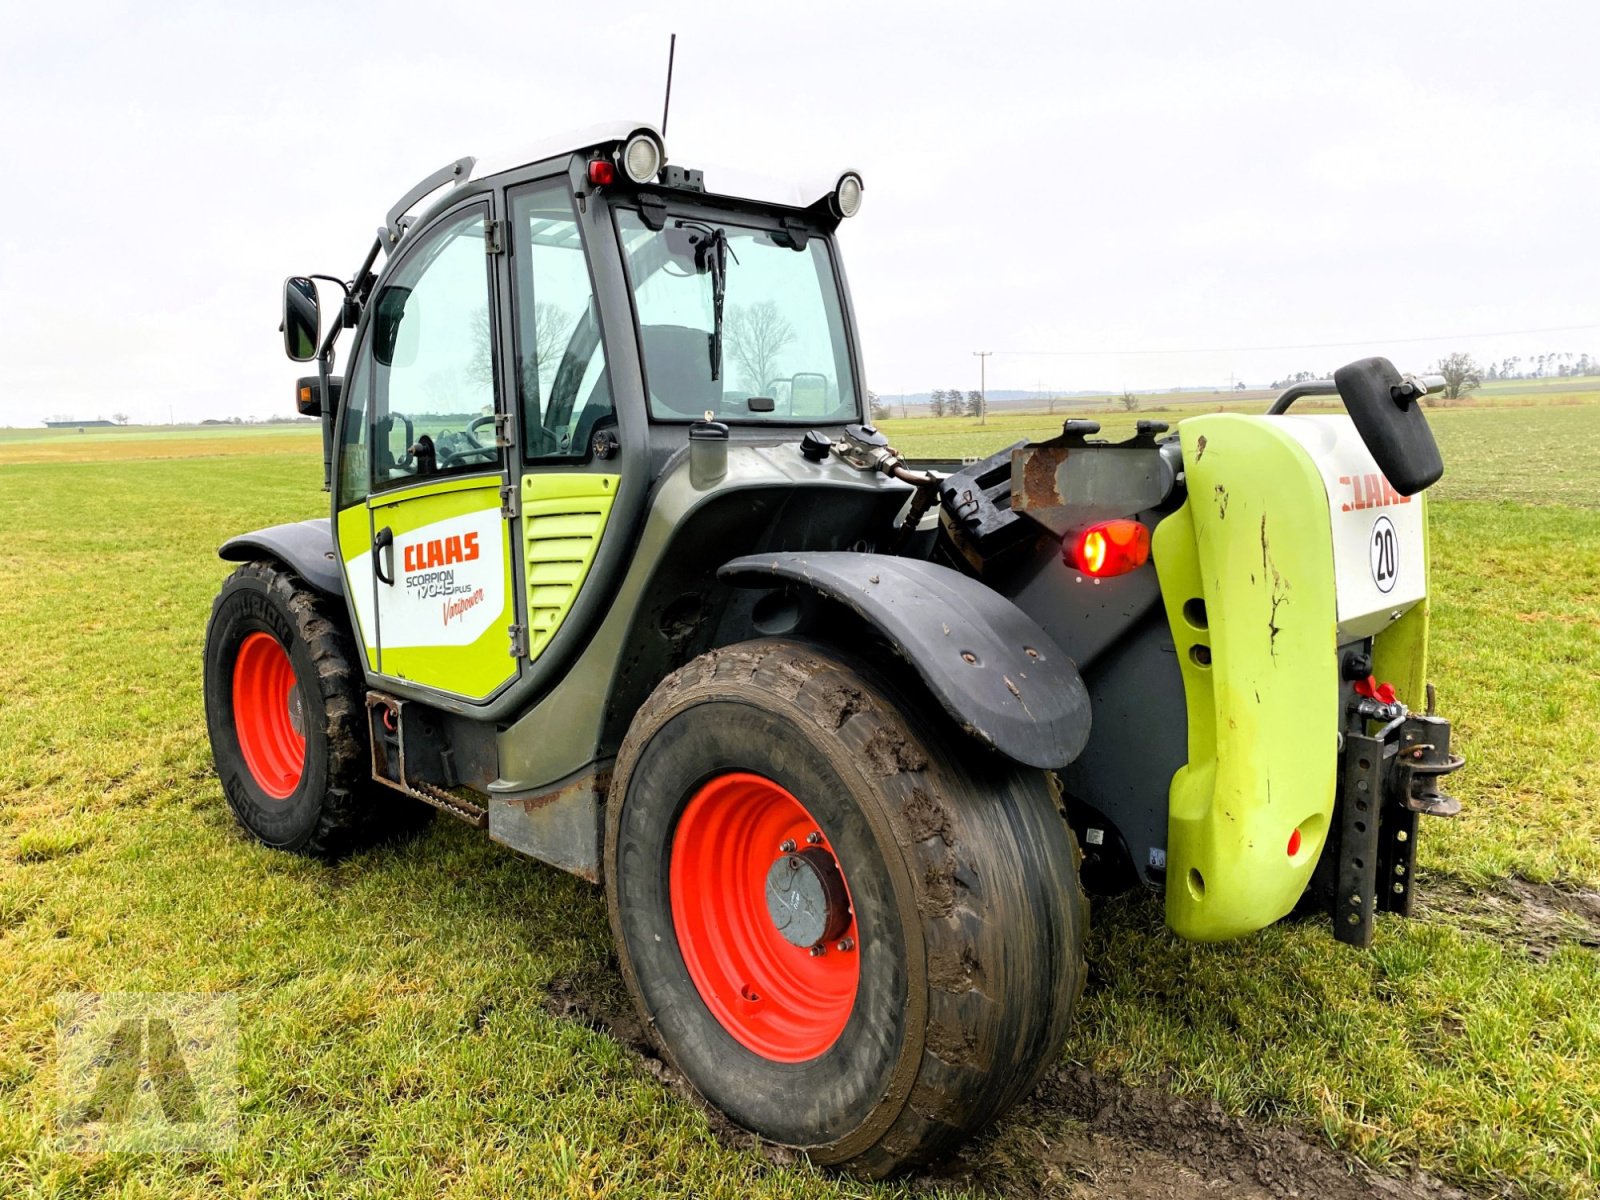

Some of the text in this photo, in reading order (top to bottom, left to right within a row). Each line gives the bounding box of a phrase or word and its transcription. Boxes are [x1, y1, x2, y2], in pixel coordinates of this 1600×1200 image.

[1339, 473, 1411, 512] CLAA
[404, 531, 479, 572] CLAAS
[1375, 528, 1394, 581] 20
[406, 569, 454, 588] SCORPION
[418, 581, 472, 599] 7045 PLUS
[443, 588, 484, 626] Varipower
